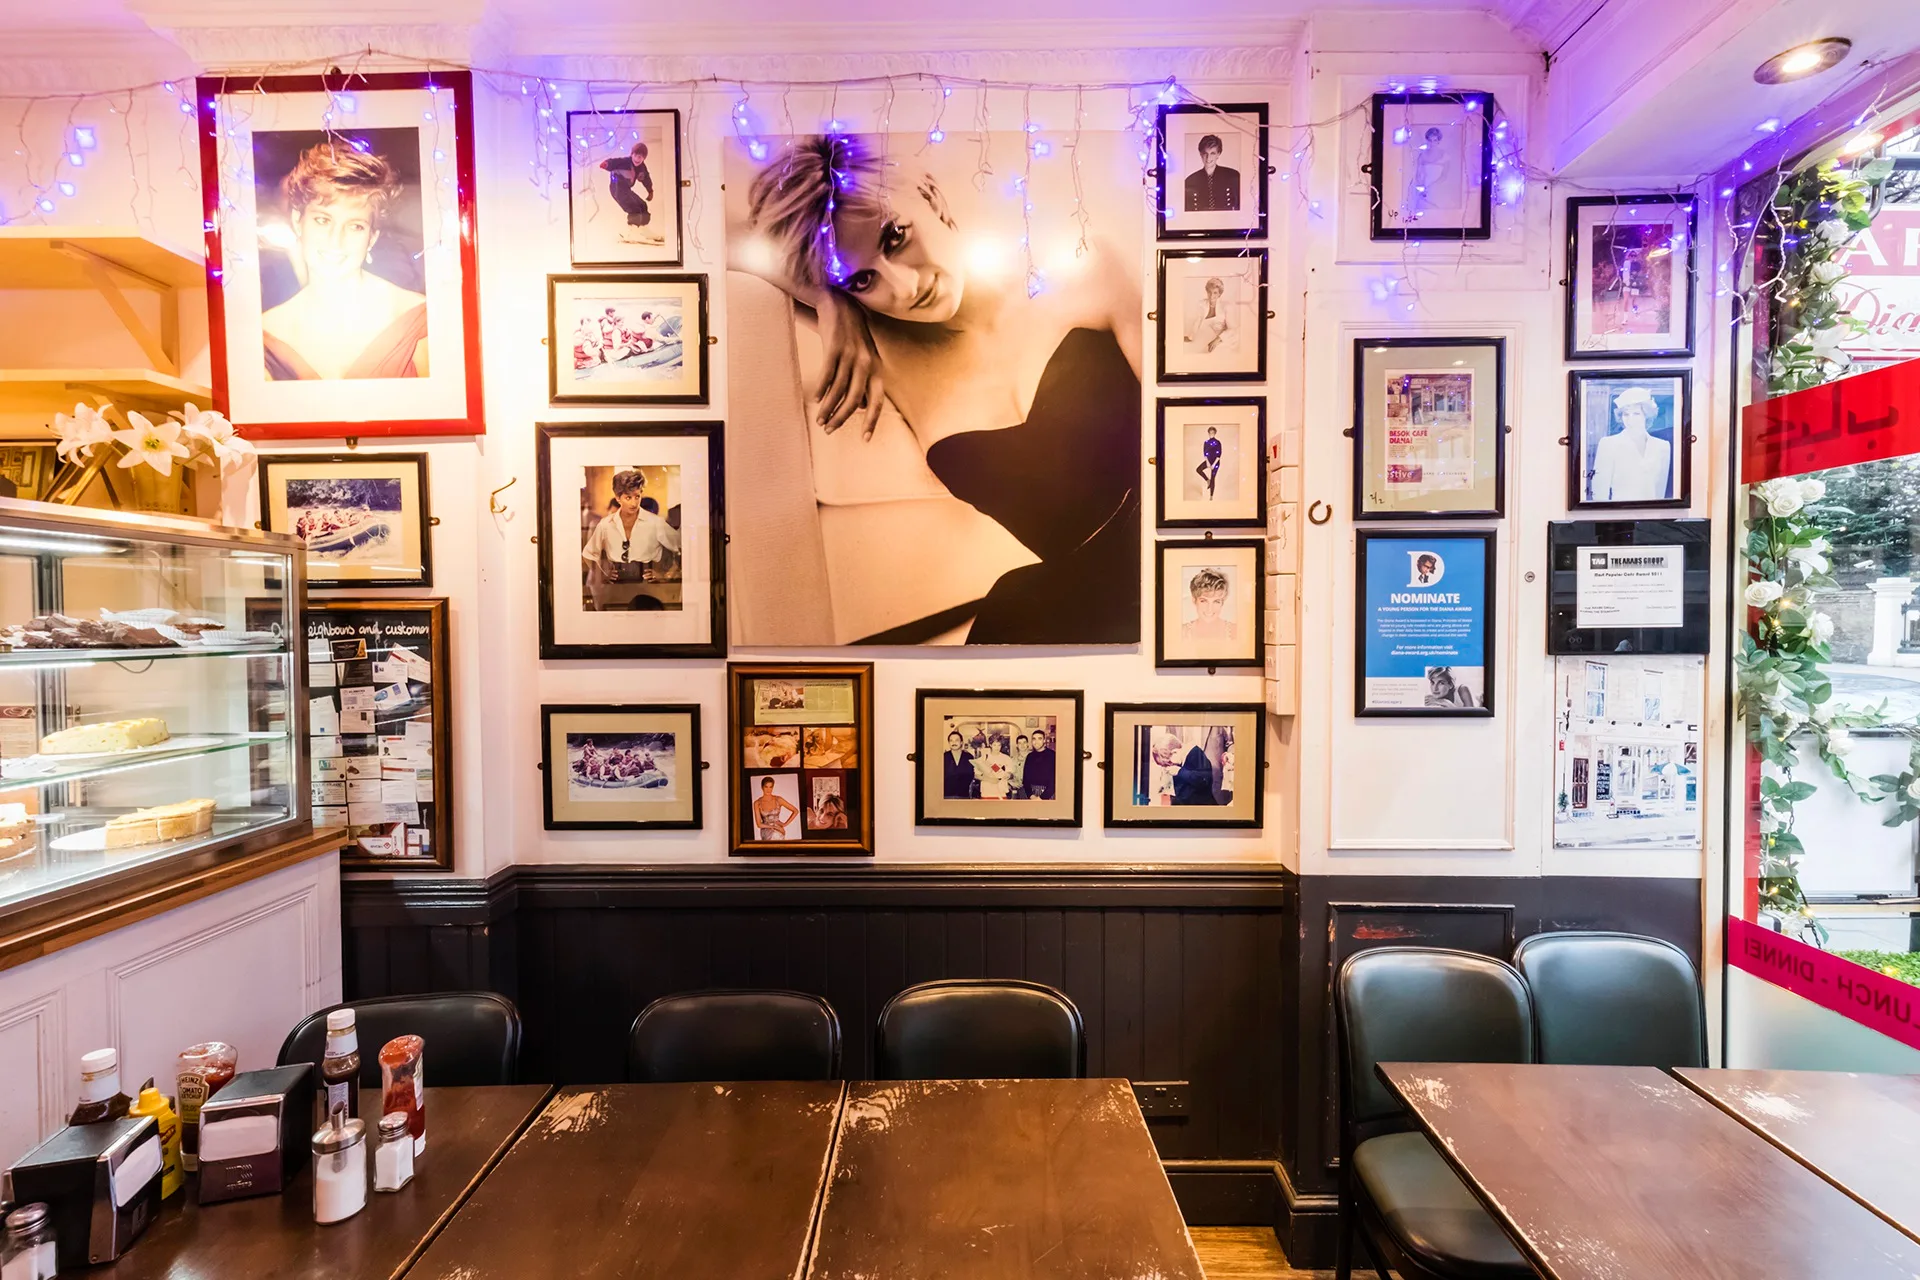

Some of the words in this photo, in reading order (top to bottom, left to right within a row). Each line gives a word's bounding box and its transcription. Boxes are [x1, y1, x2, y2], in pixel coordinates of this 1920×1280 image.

[1391, 593, 1460, 604] NOMINATE
[308, 622, 355, 639] eighbours
[359, 621, 383, 636] and
[181, 1076, 199, 1084] HEINZ
